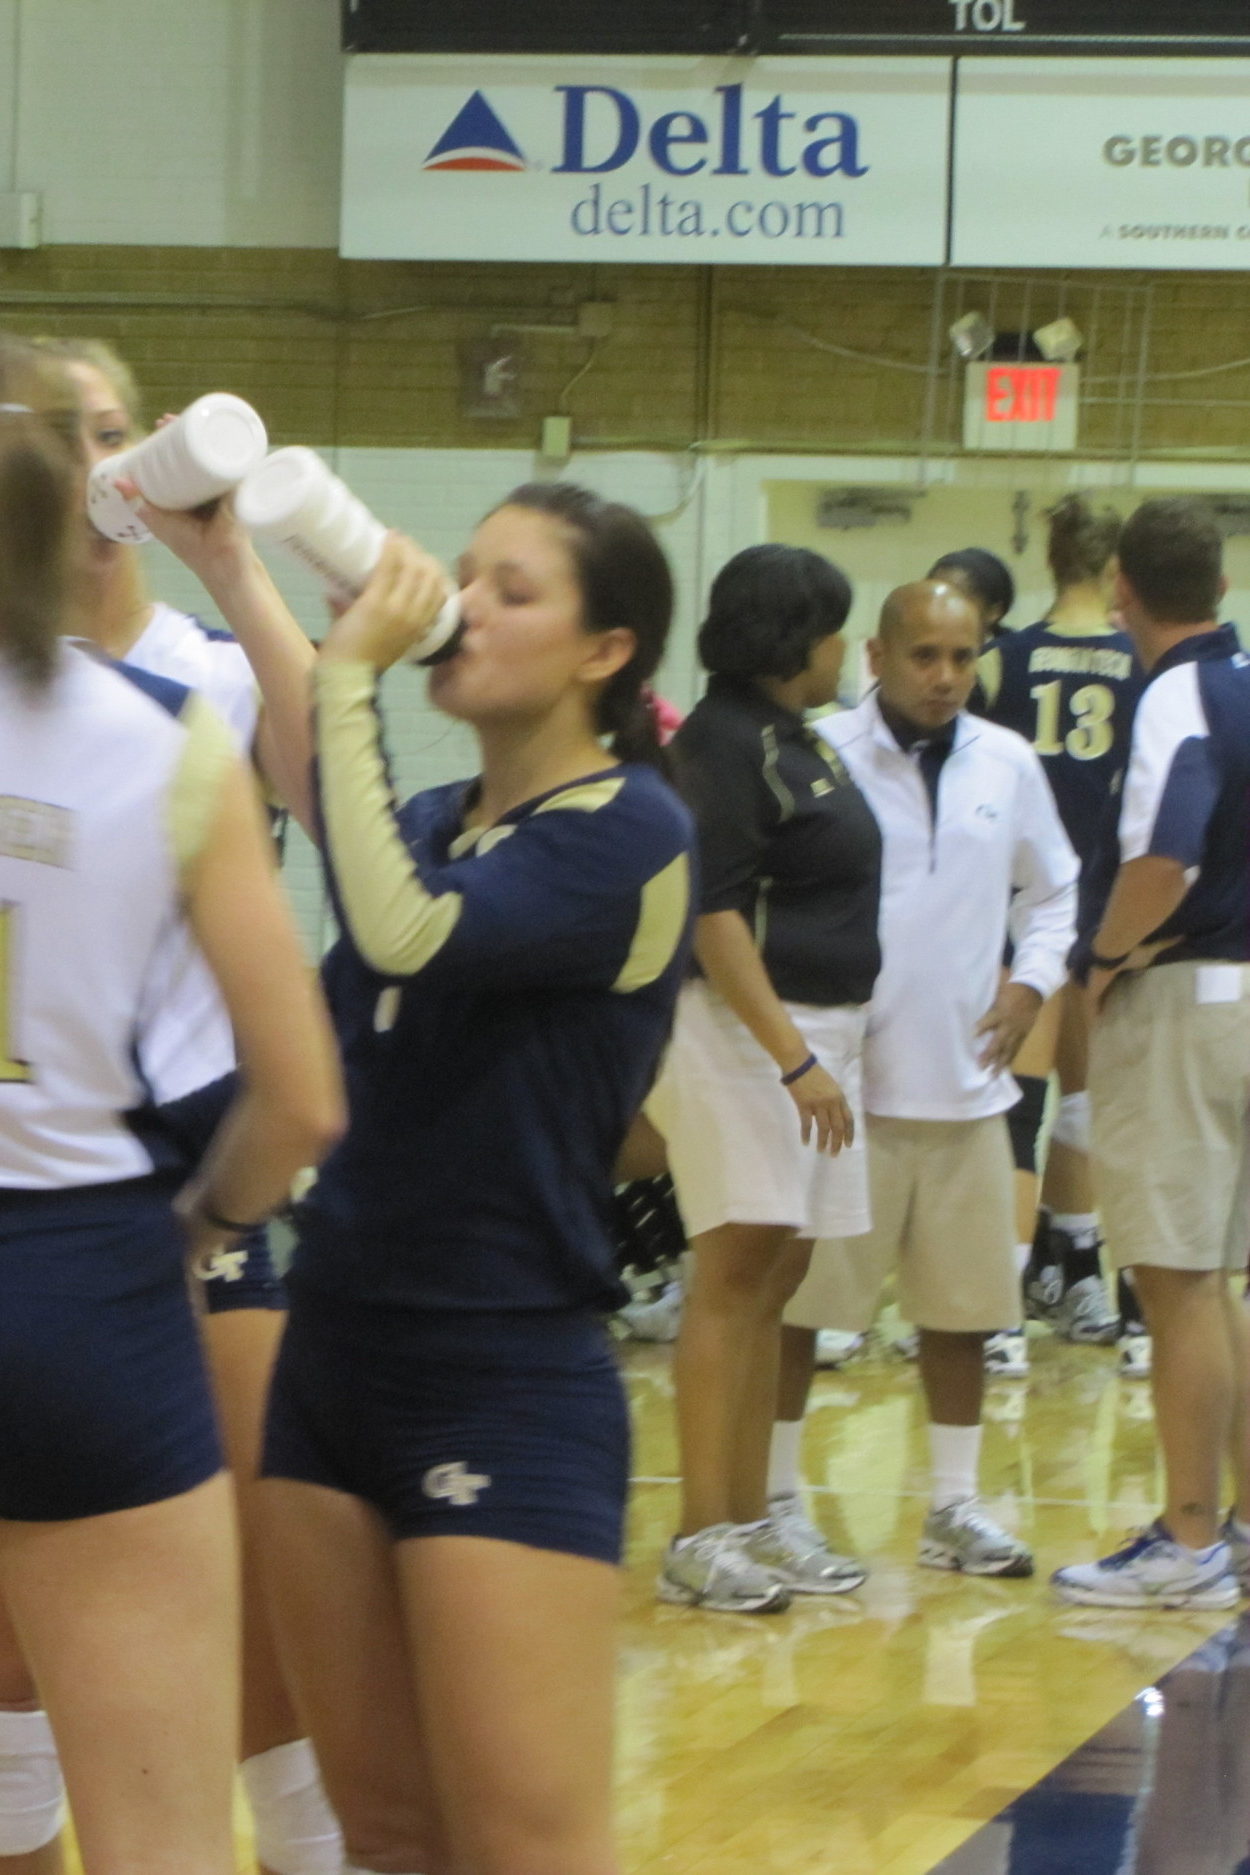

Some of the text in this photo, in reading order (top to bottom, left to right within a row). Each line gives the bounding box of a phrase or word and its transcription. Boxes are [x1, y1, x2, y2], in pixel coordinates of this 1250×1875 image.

[948, 0, 1026, 31] TOL
[551, 82, 869, 178] Delta
[571, 182, 844, 239] delta.com
[986, 367, 1061, 422] EXIT
[1030, 680, 1115, 761] 13
